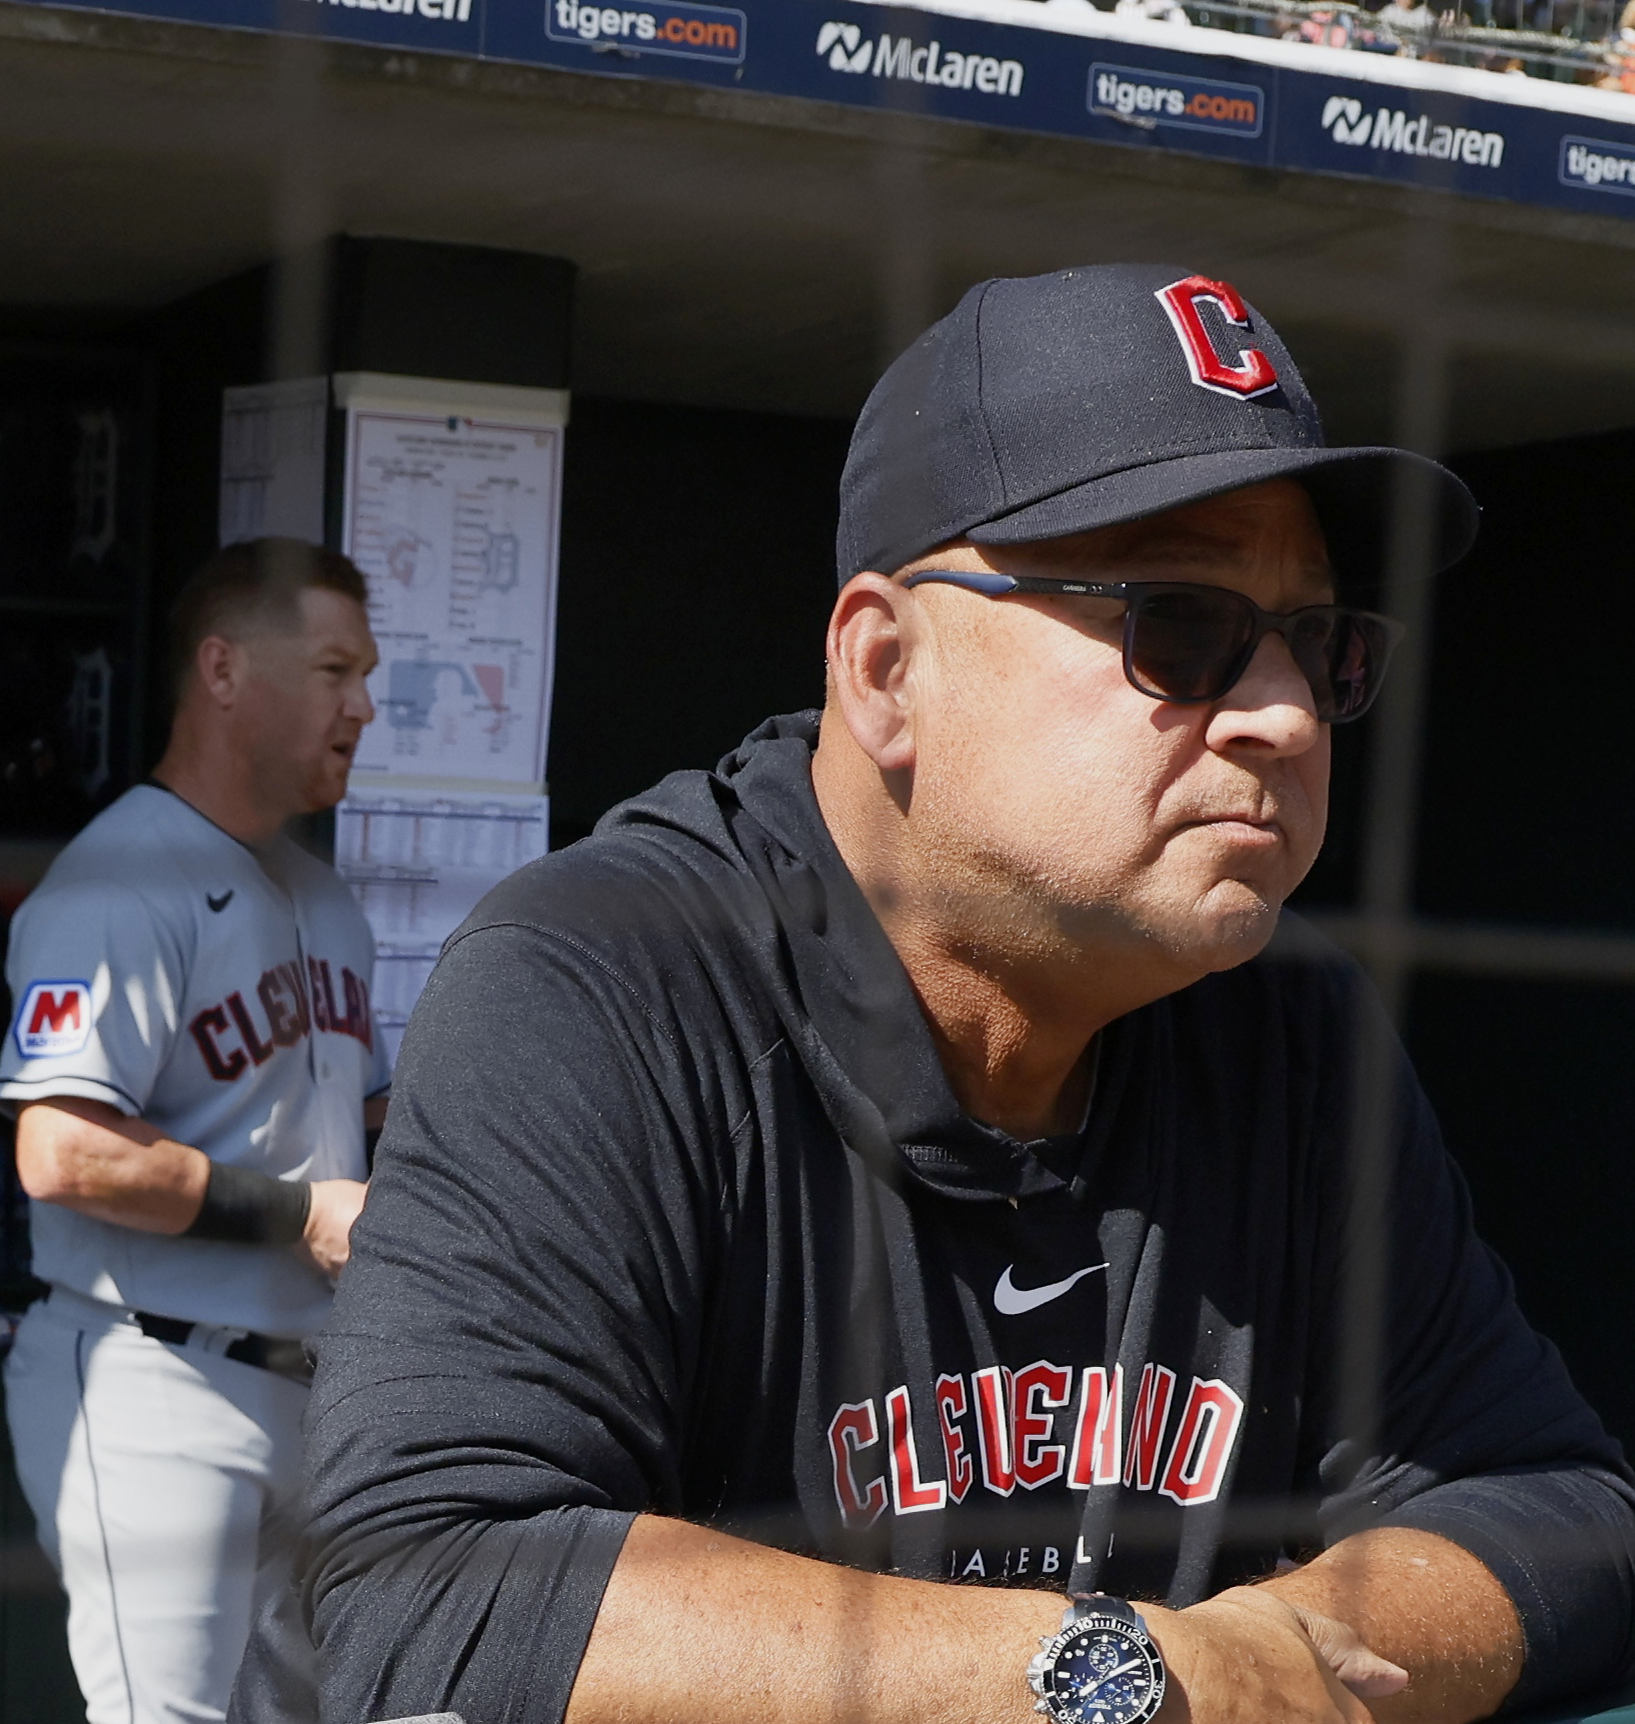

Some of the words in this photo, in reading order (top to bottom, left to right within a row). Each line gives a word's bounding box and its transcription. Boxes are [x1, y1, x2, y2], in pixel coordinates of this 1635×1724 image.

[556, 0, 736, 48] tigers.com
[873, 35, 1024, 96] McLaren
[1097, 73, 1256, 123] tigers.com
[1370, 108, 1503, 168] McLaren
[1154, 274, 1277, 400] C
[28, 990, 80, 1034] M
